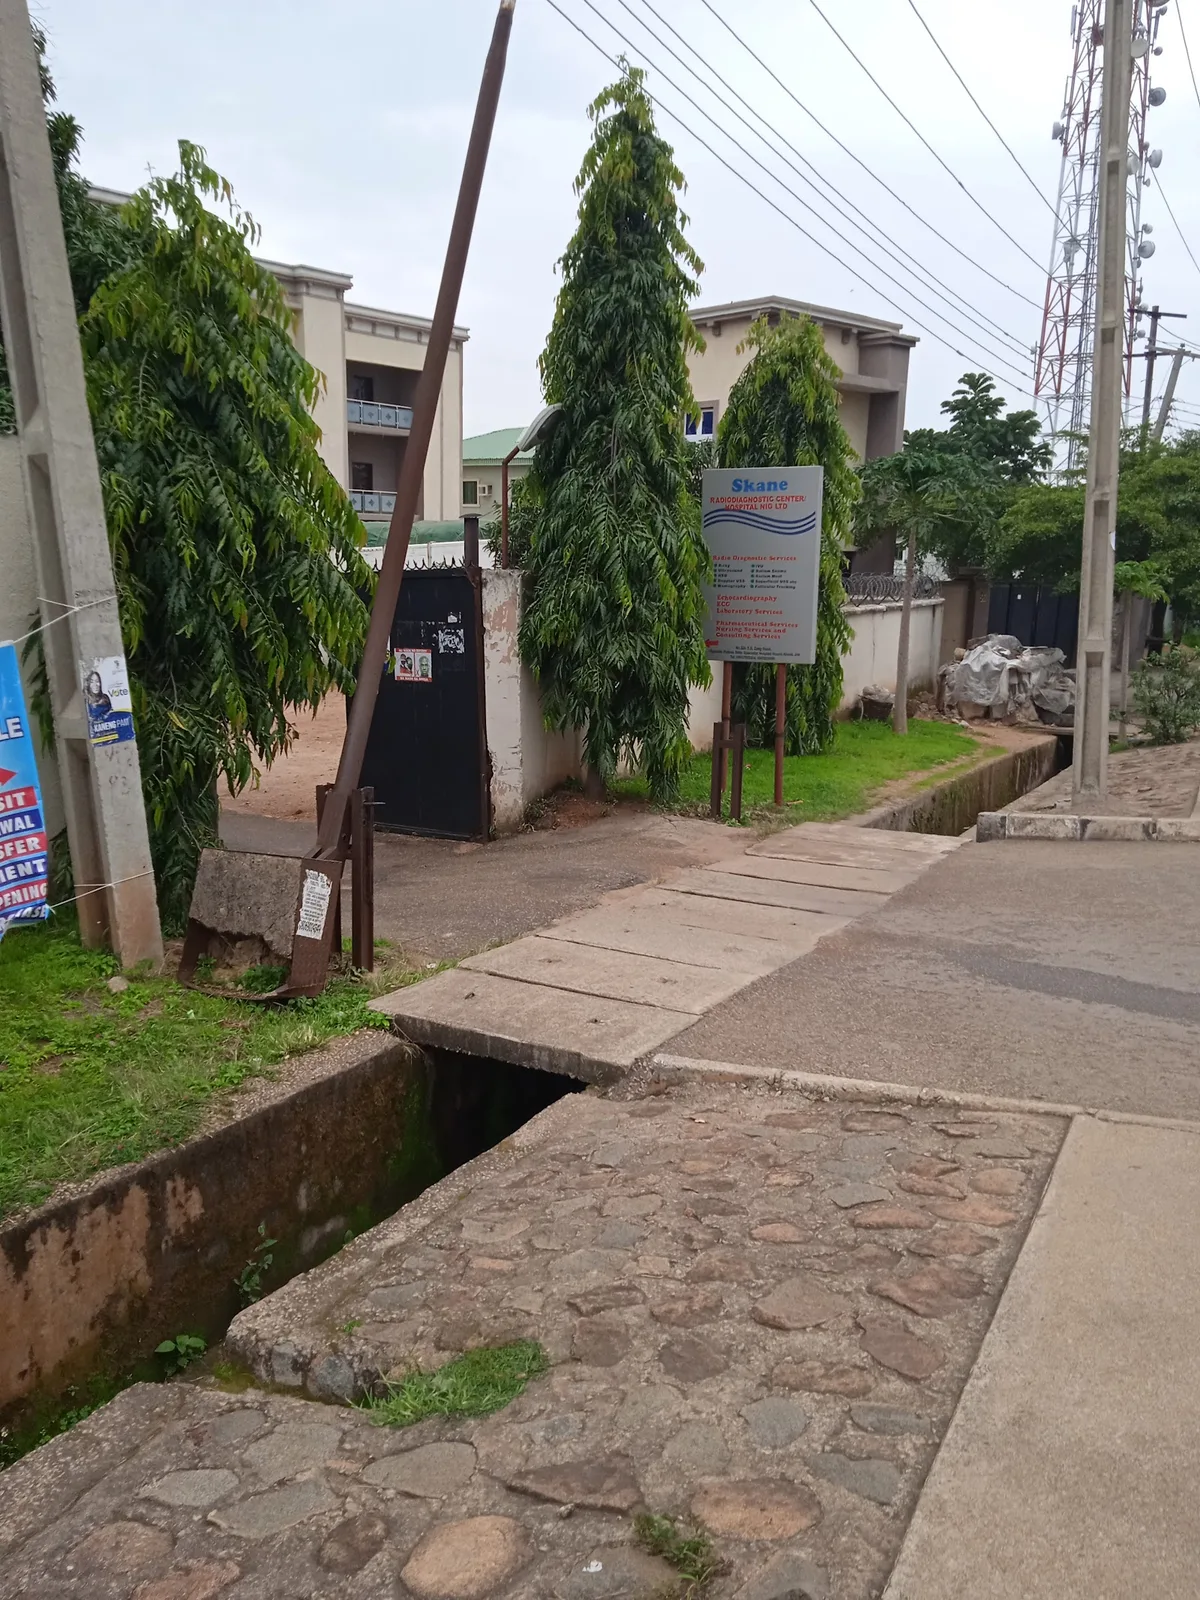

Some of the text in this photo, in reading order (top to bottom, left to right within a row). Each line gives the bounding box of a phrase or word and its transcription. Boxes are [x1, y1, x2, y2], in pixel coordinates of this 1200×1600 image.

[731, 478, 788, 492] Skane
[724, 503, 758, 511] HOSPITAL
[717, 594, 777, 602] Echocardiography
[108, 688, 129, 698] Vote
